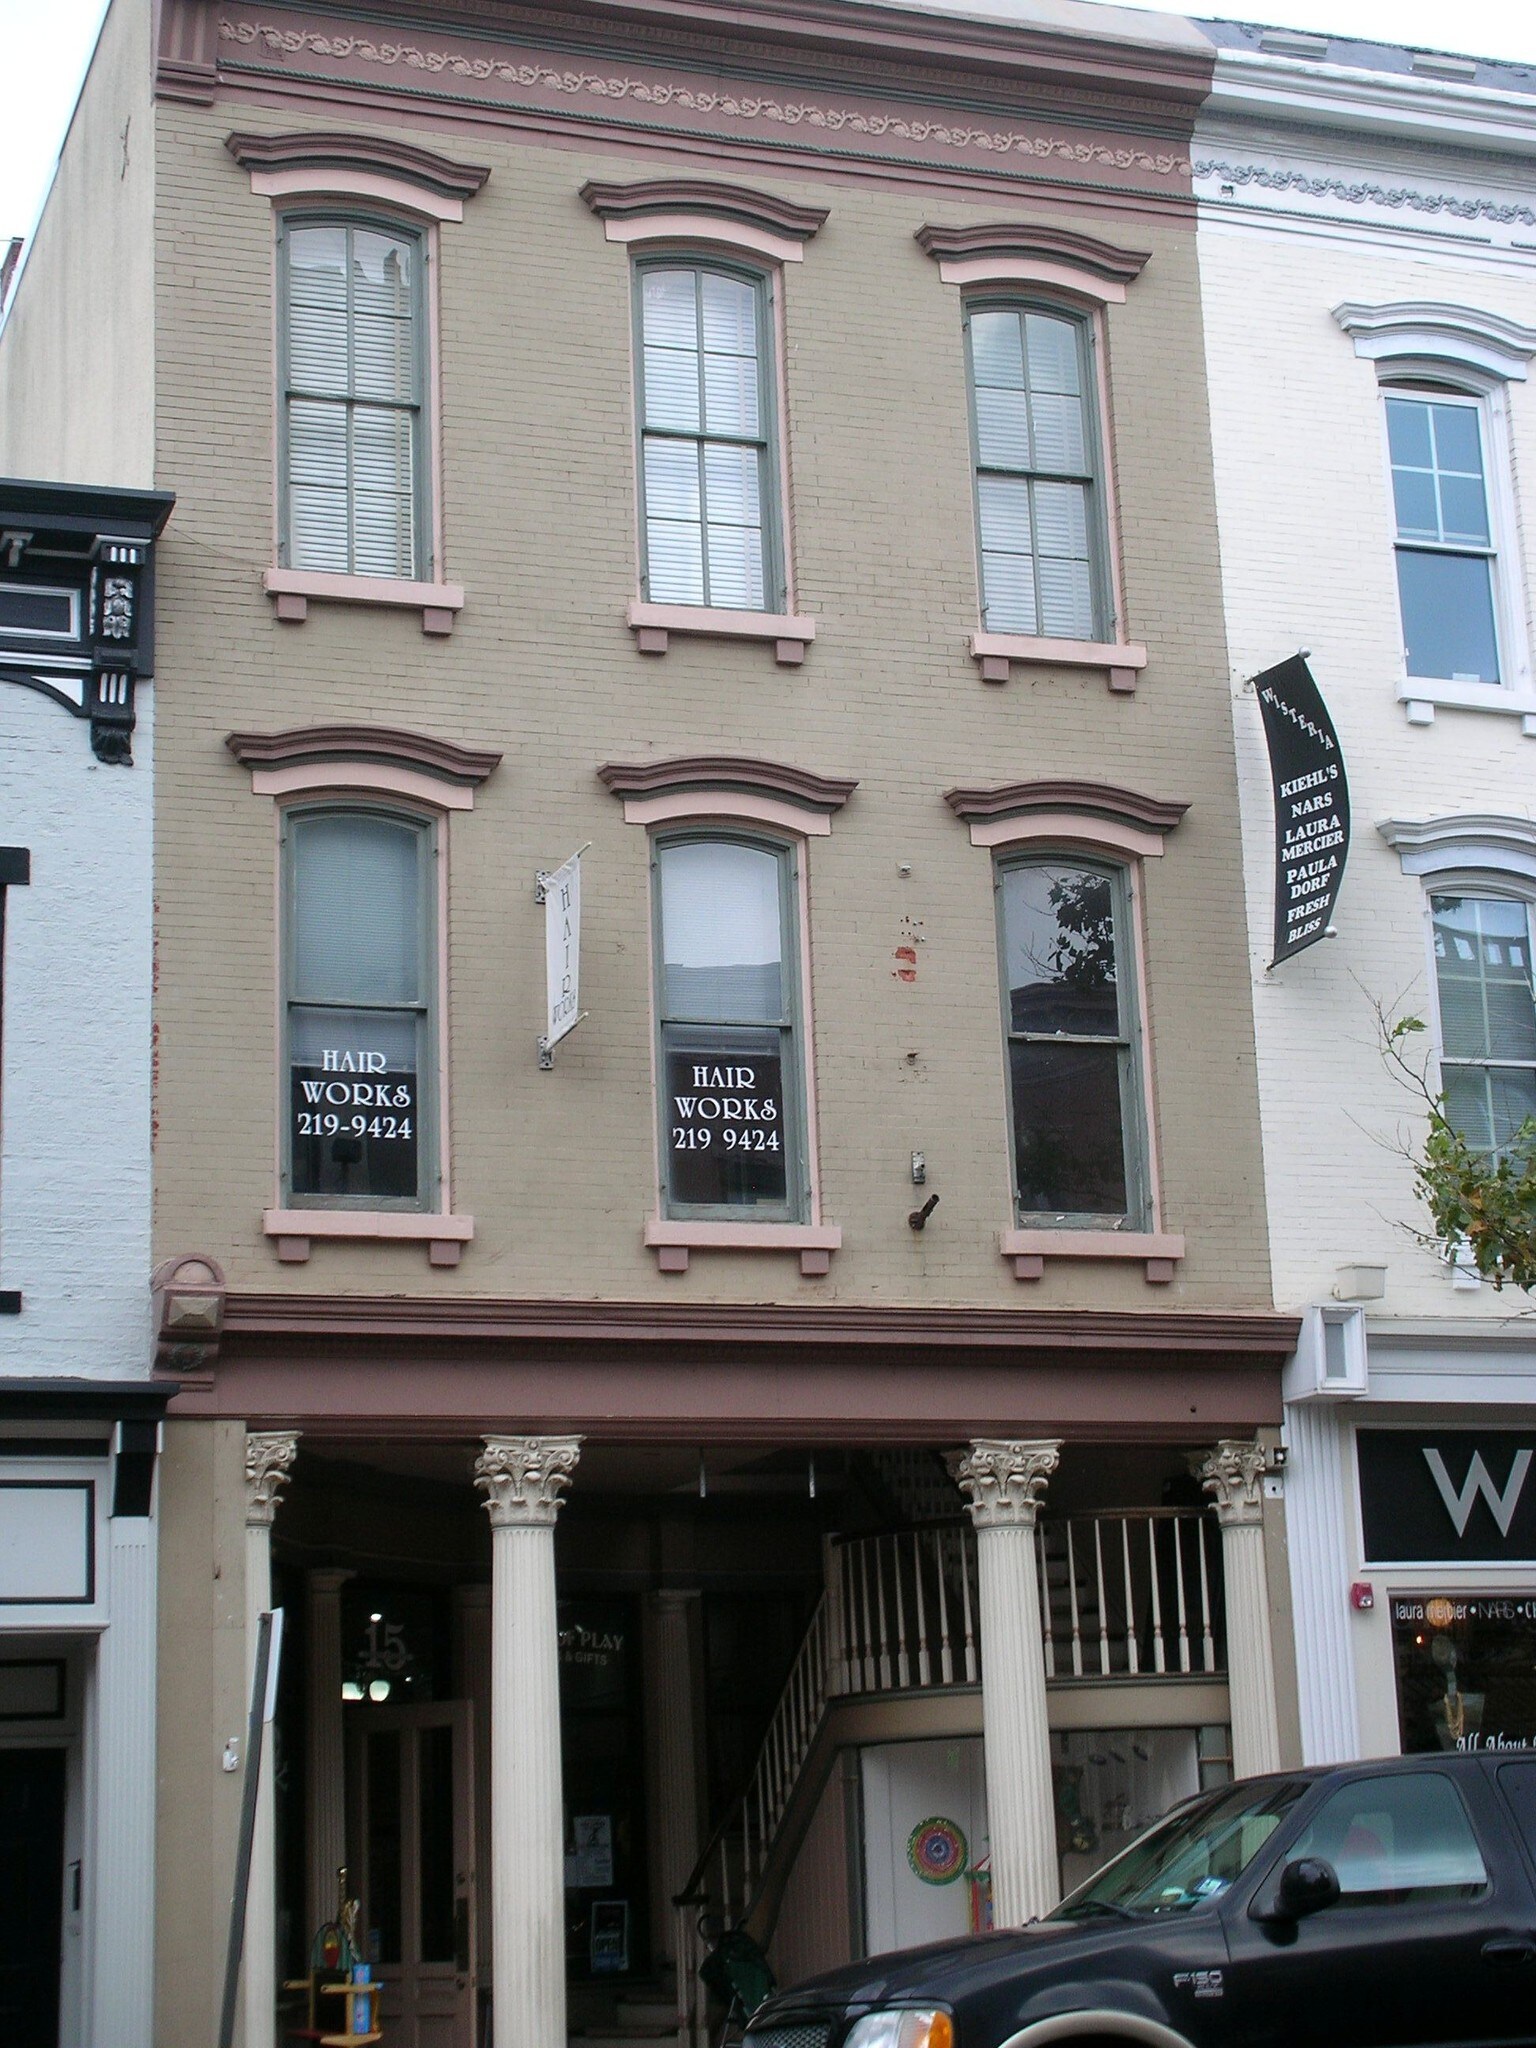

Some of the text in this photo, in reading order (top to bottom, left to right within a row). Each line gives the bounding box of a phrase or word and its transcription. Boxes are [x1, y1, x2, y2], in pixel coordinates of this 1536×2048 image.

[1261, 686, 1334, 750] WISTERIA
[1280, 764, 1339, 798] KIEHL'S
[1291, 792, 1333, 818] NARS
[1285, 814, 1341, 844] LAURA
[1281, 830, 1344, 862] MERCIER
[1286, 854, 1338, 884] PAULA
[1290, 872, 1331, 900] DORF
[1287, 893, 1331, 923] FRESH
[1287, 917, 1322, 944] BLISS
[321, 1049, 388, 1075] HAIR
[692, 1065, 756, 1089] HAIR
[300, 1080, 411, 1108] WORKS
[673, 1096, 777, 1121] WORKS
[297, 1112, 413, 1140] 219-9424
[672, 1126, 780, 1151] 219 9424
[1422, 1448, 1534, 1539] W
[1395, 1601, 1424, 1620] laura
[1478, 1600, 1515, 1621] NARS
[364, 1618, 407, 1671] 15
[580, 1631, 624, 1652] PLAY
[574, 1651, 608, 1666] GIFTS
[1485, 1730, 1528, 1751] About
